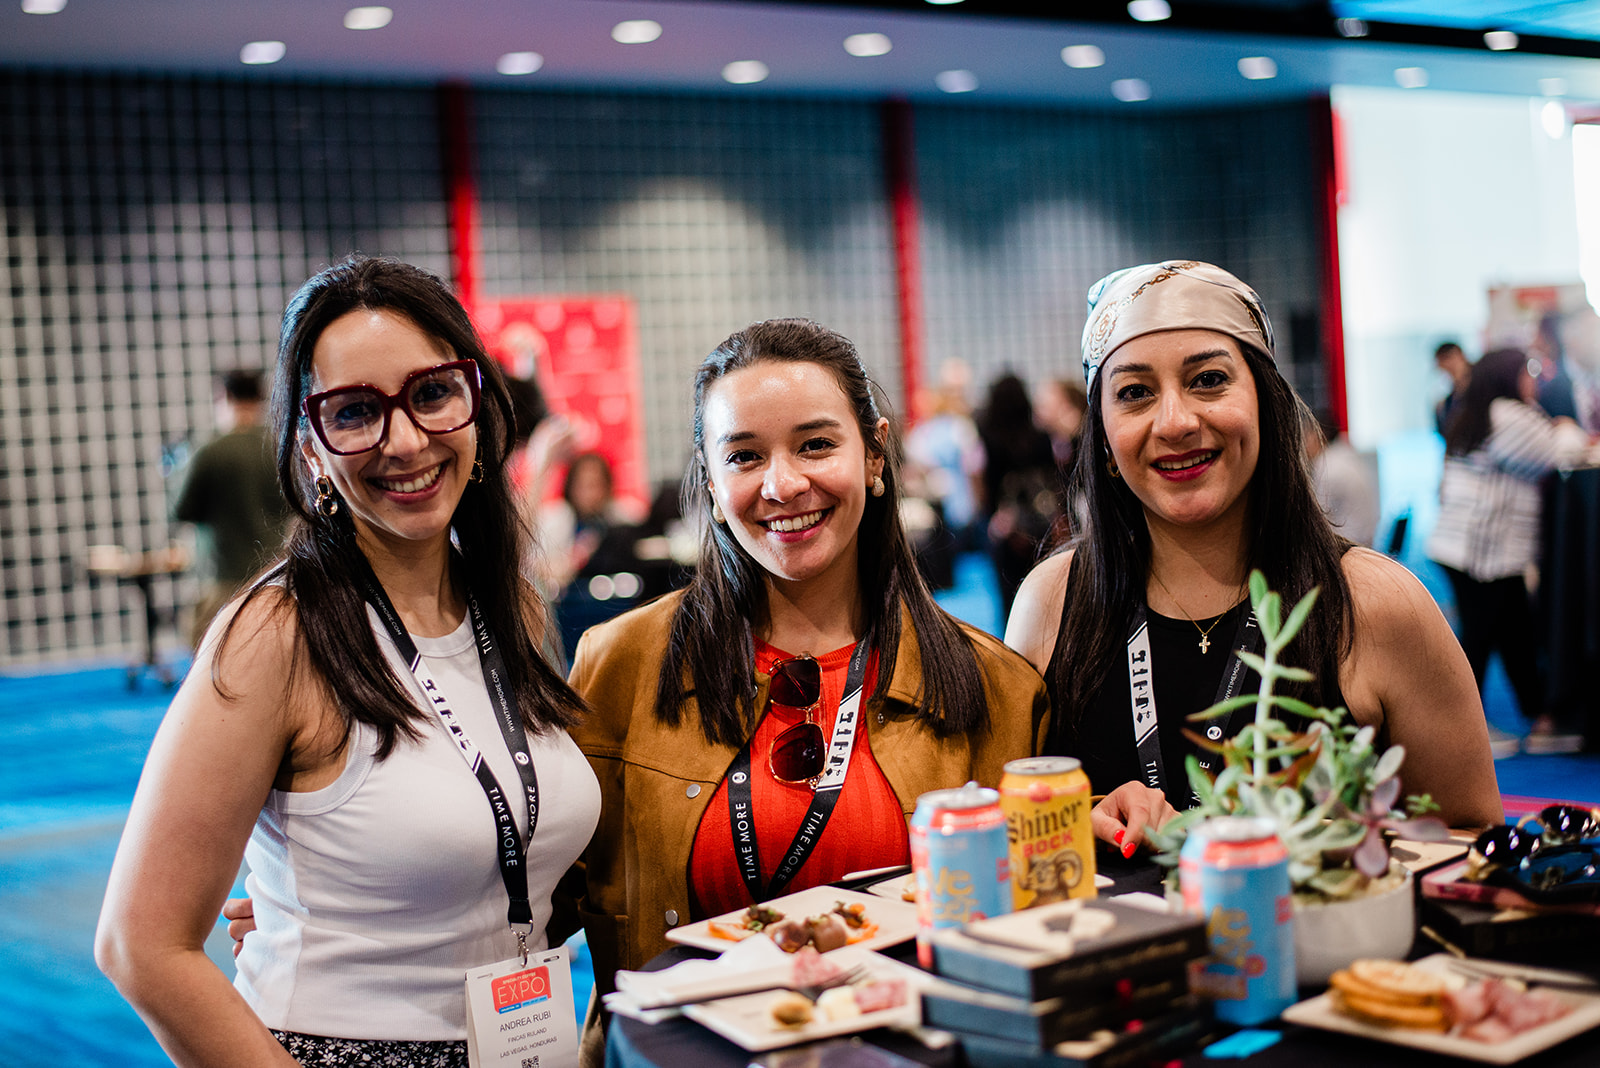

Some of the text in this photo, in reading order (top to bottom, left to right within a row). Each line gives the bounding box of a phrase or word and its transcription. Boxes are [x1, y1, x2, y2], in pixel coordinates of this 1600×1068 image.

[1145, 760, 1161, 789] TIM
[1007, 801, 1083, 844] Shiner
[1023, 828, 1074, 859] BOCK
[497, 976, 545, 1005] EXPO
[500, 1010, 551, 1032] ANDREA RUBI
[507, 1027, 547, 1043] FINCAS RULAND
[499, 1051, 510, 1059] LAS
[529, 1037, 557, 1049] HONDURAS
